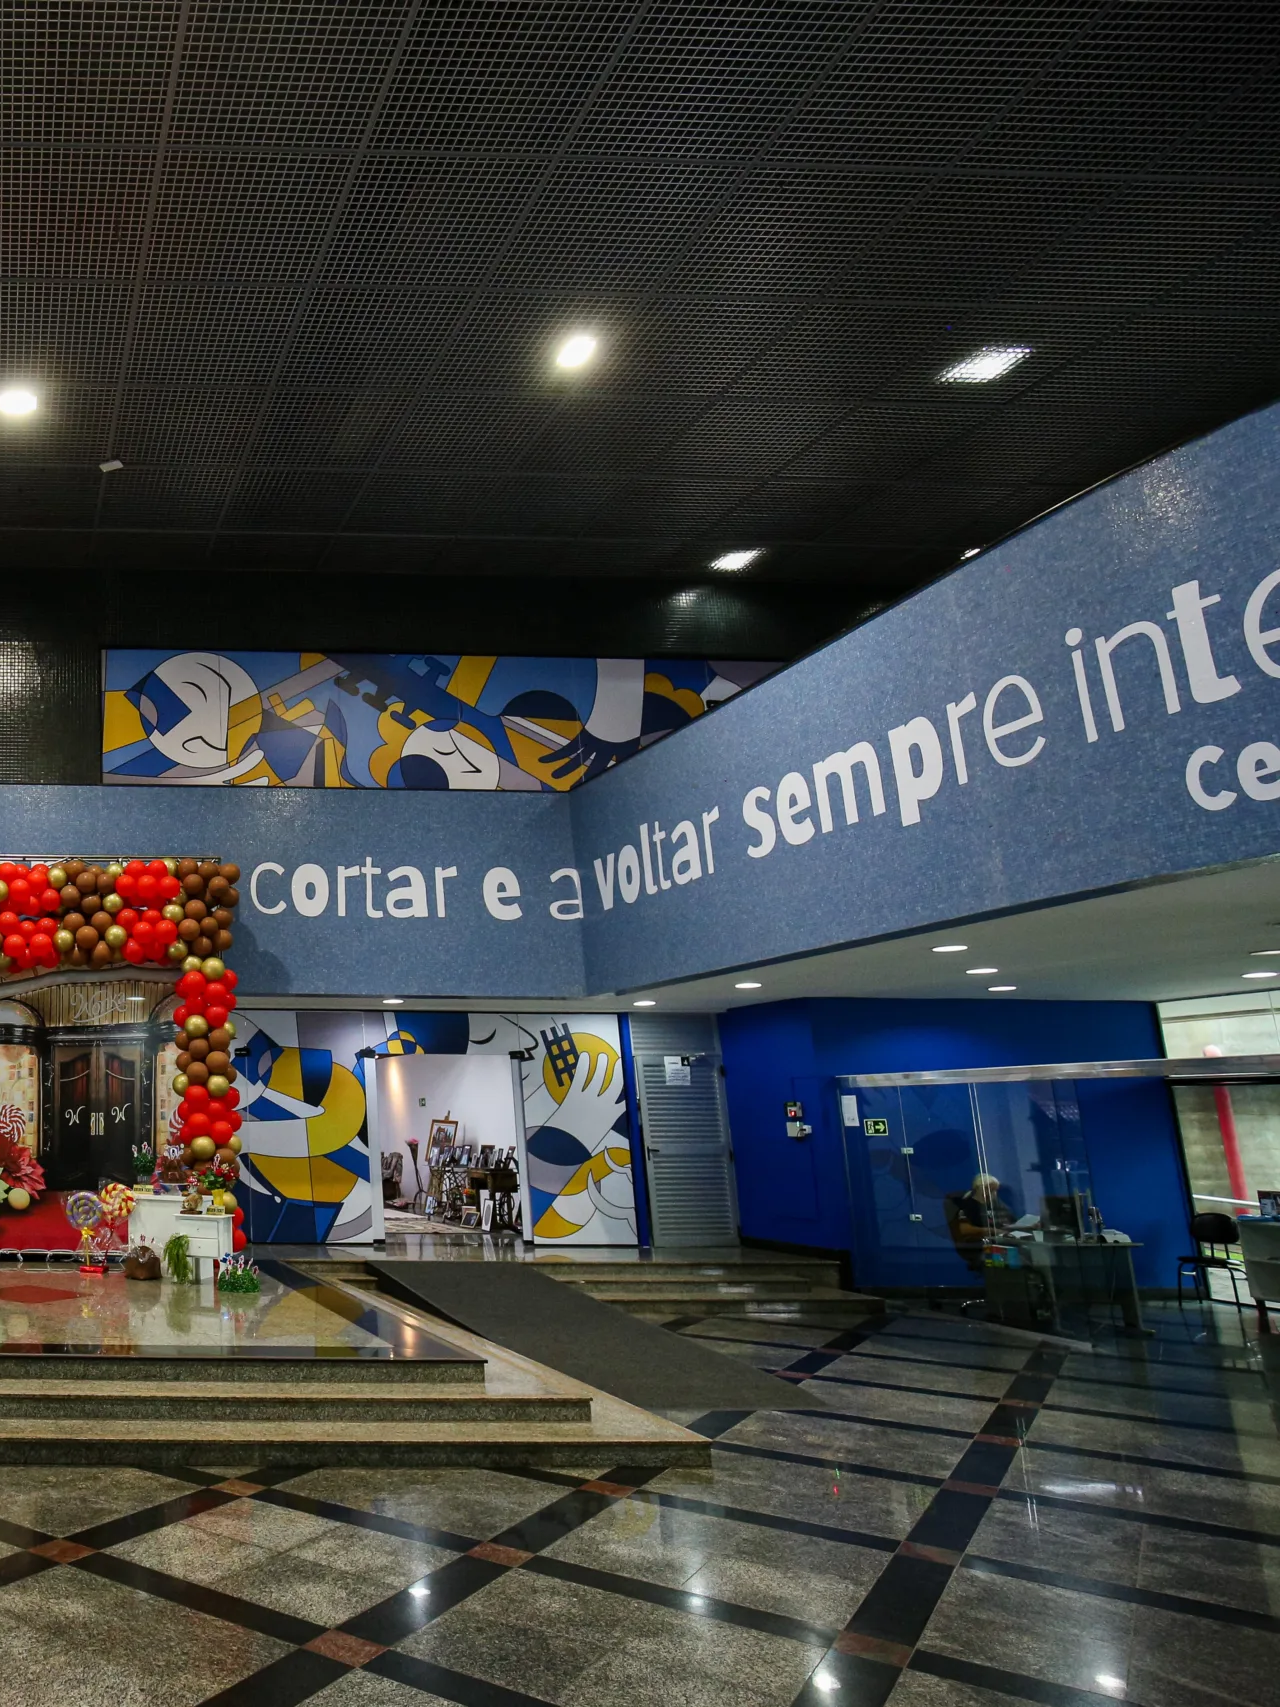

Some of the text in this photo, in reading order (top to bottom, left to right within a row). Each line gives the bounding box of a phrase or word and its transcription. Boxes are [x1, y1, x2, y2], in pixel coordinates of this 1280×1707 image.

[250, 856, 457, 919] cortar
[482, 867, 523, 920] e
[549, 868, 584, 920] a
[593, 806, 720, 910] voltar
[742, 675, 1047, 859] sempre
